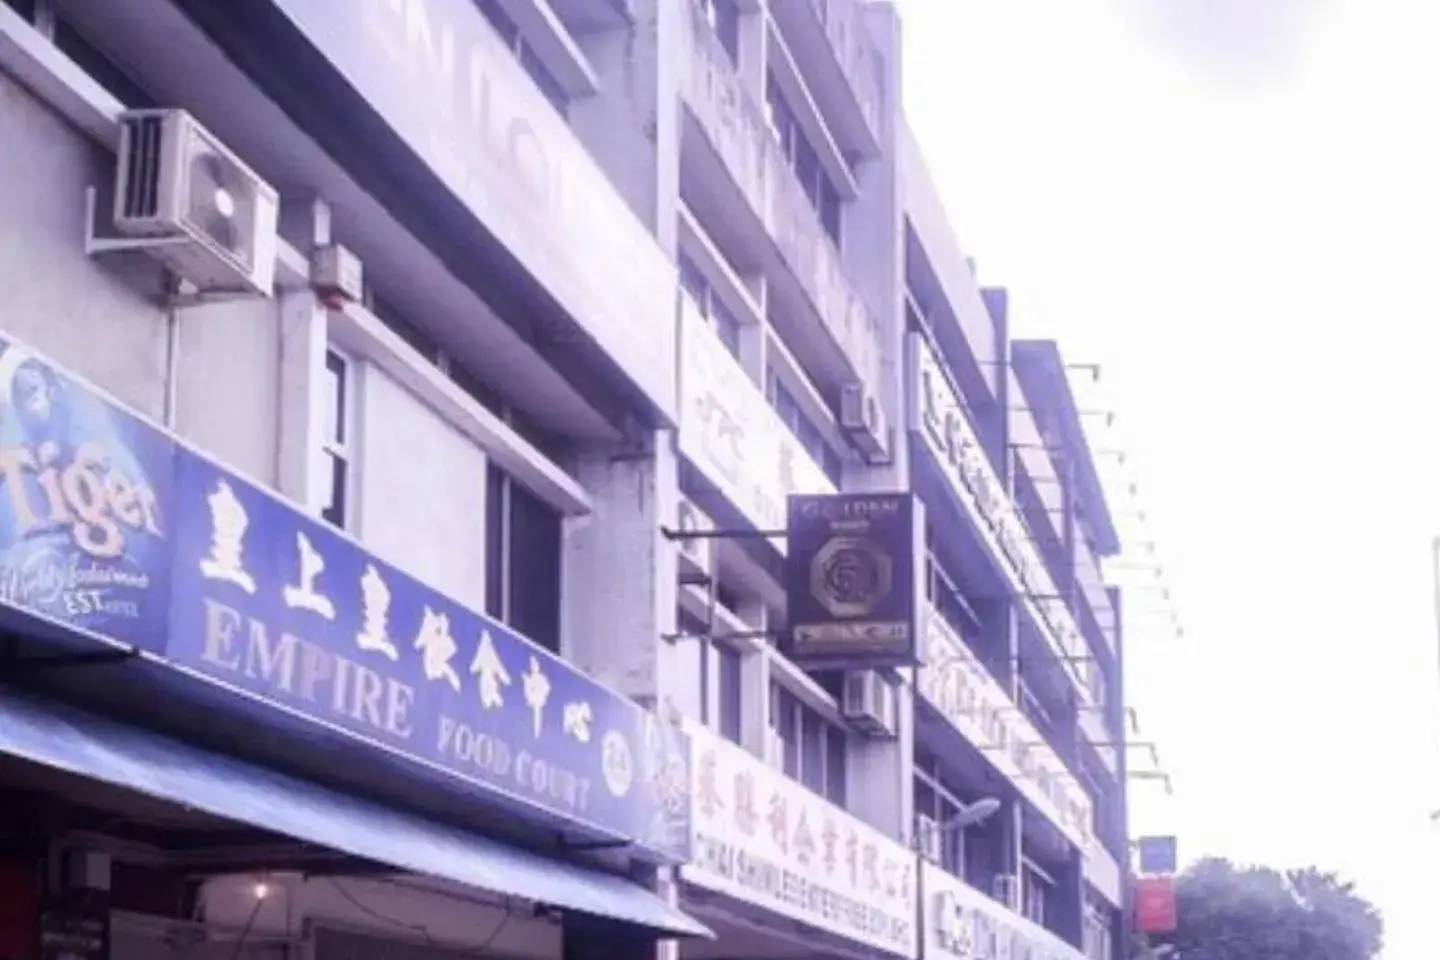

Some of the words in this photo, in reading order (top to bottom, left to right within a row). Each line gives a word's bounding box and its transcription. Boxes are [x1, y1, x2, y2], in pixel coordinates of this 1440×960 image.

[0, 442, 166, 557] Tiger
[201, 596, 415, 739] EMPIRE
[437, 715, 512, 779] FOOD
[514, 749, 593, 812] COURT
